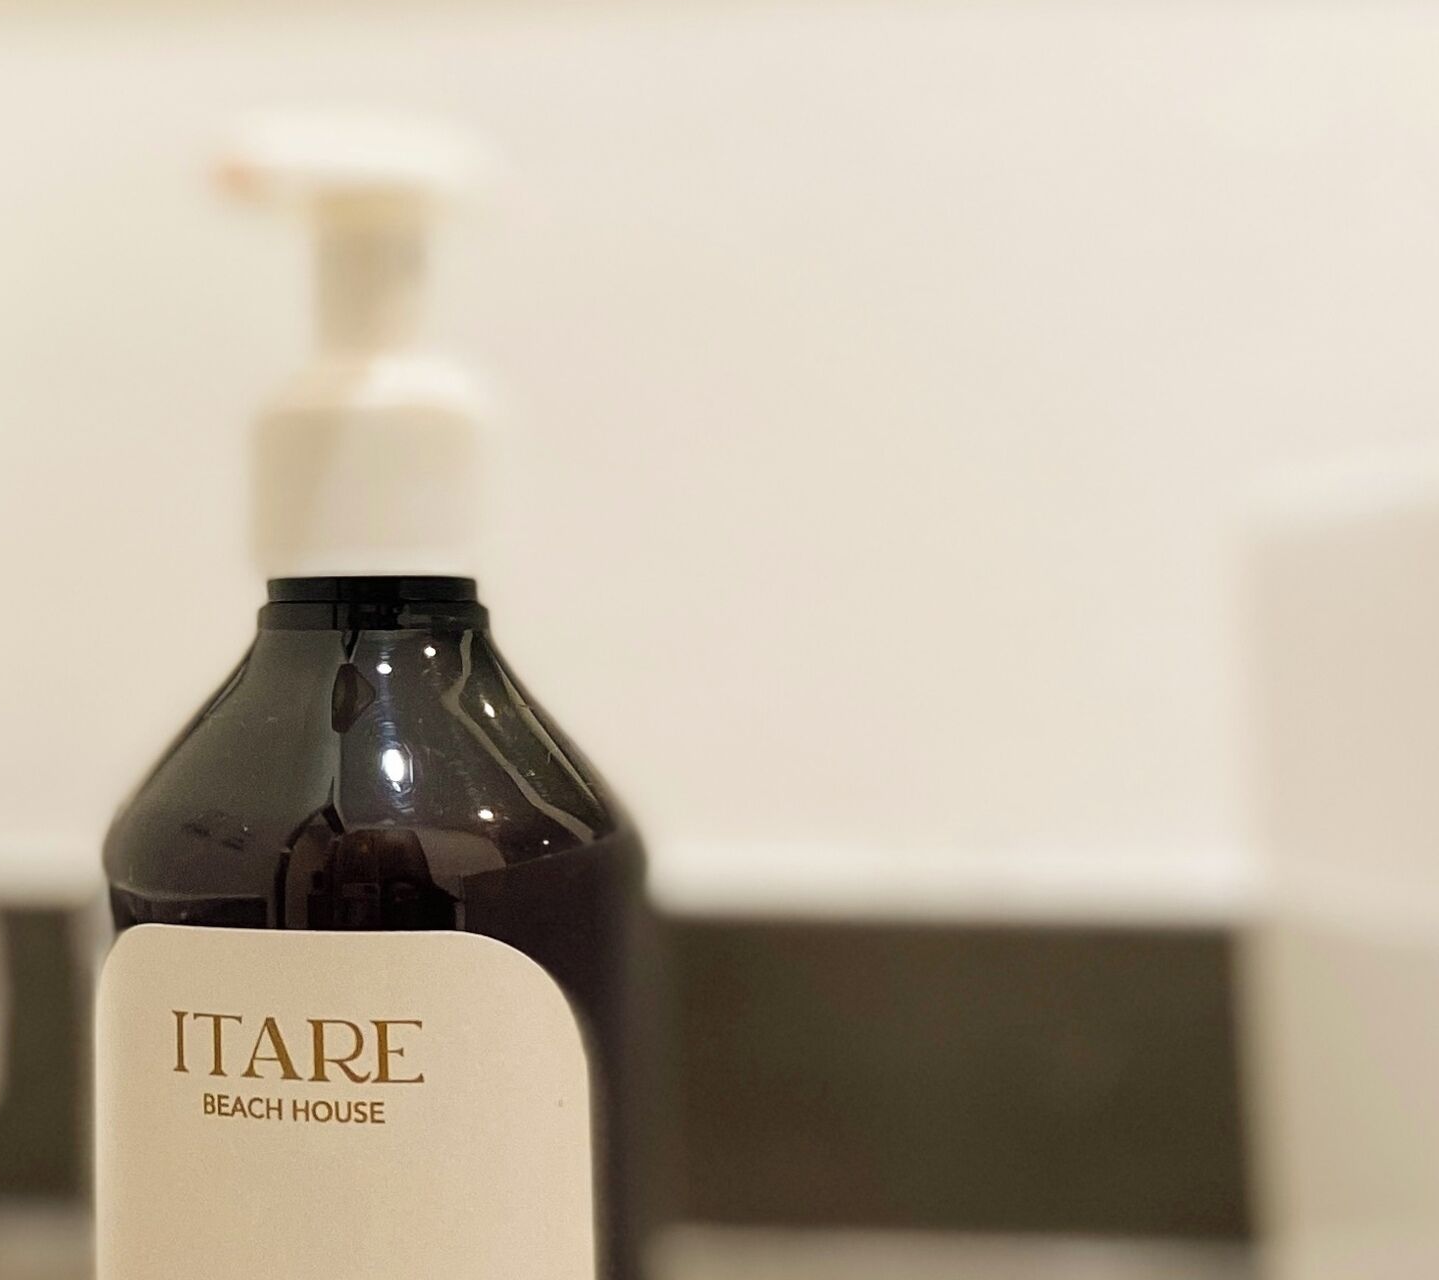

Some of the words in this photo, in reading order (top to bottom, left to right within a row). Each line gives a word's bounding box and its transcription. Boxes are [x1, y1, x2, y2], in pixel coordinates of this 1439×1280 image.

[171, 1009, 425, 1084] ITARE
[203, 1092, 283, 1121] BEACH
[292, 1099, 386, 1125] HOUSE
